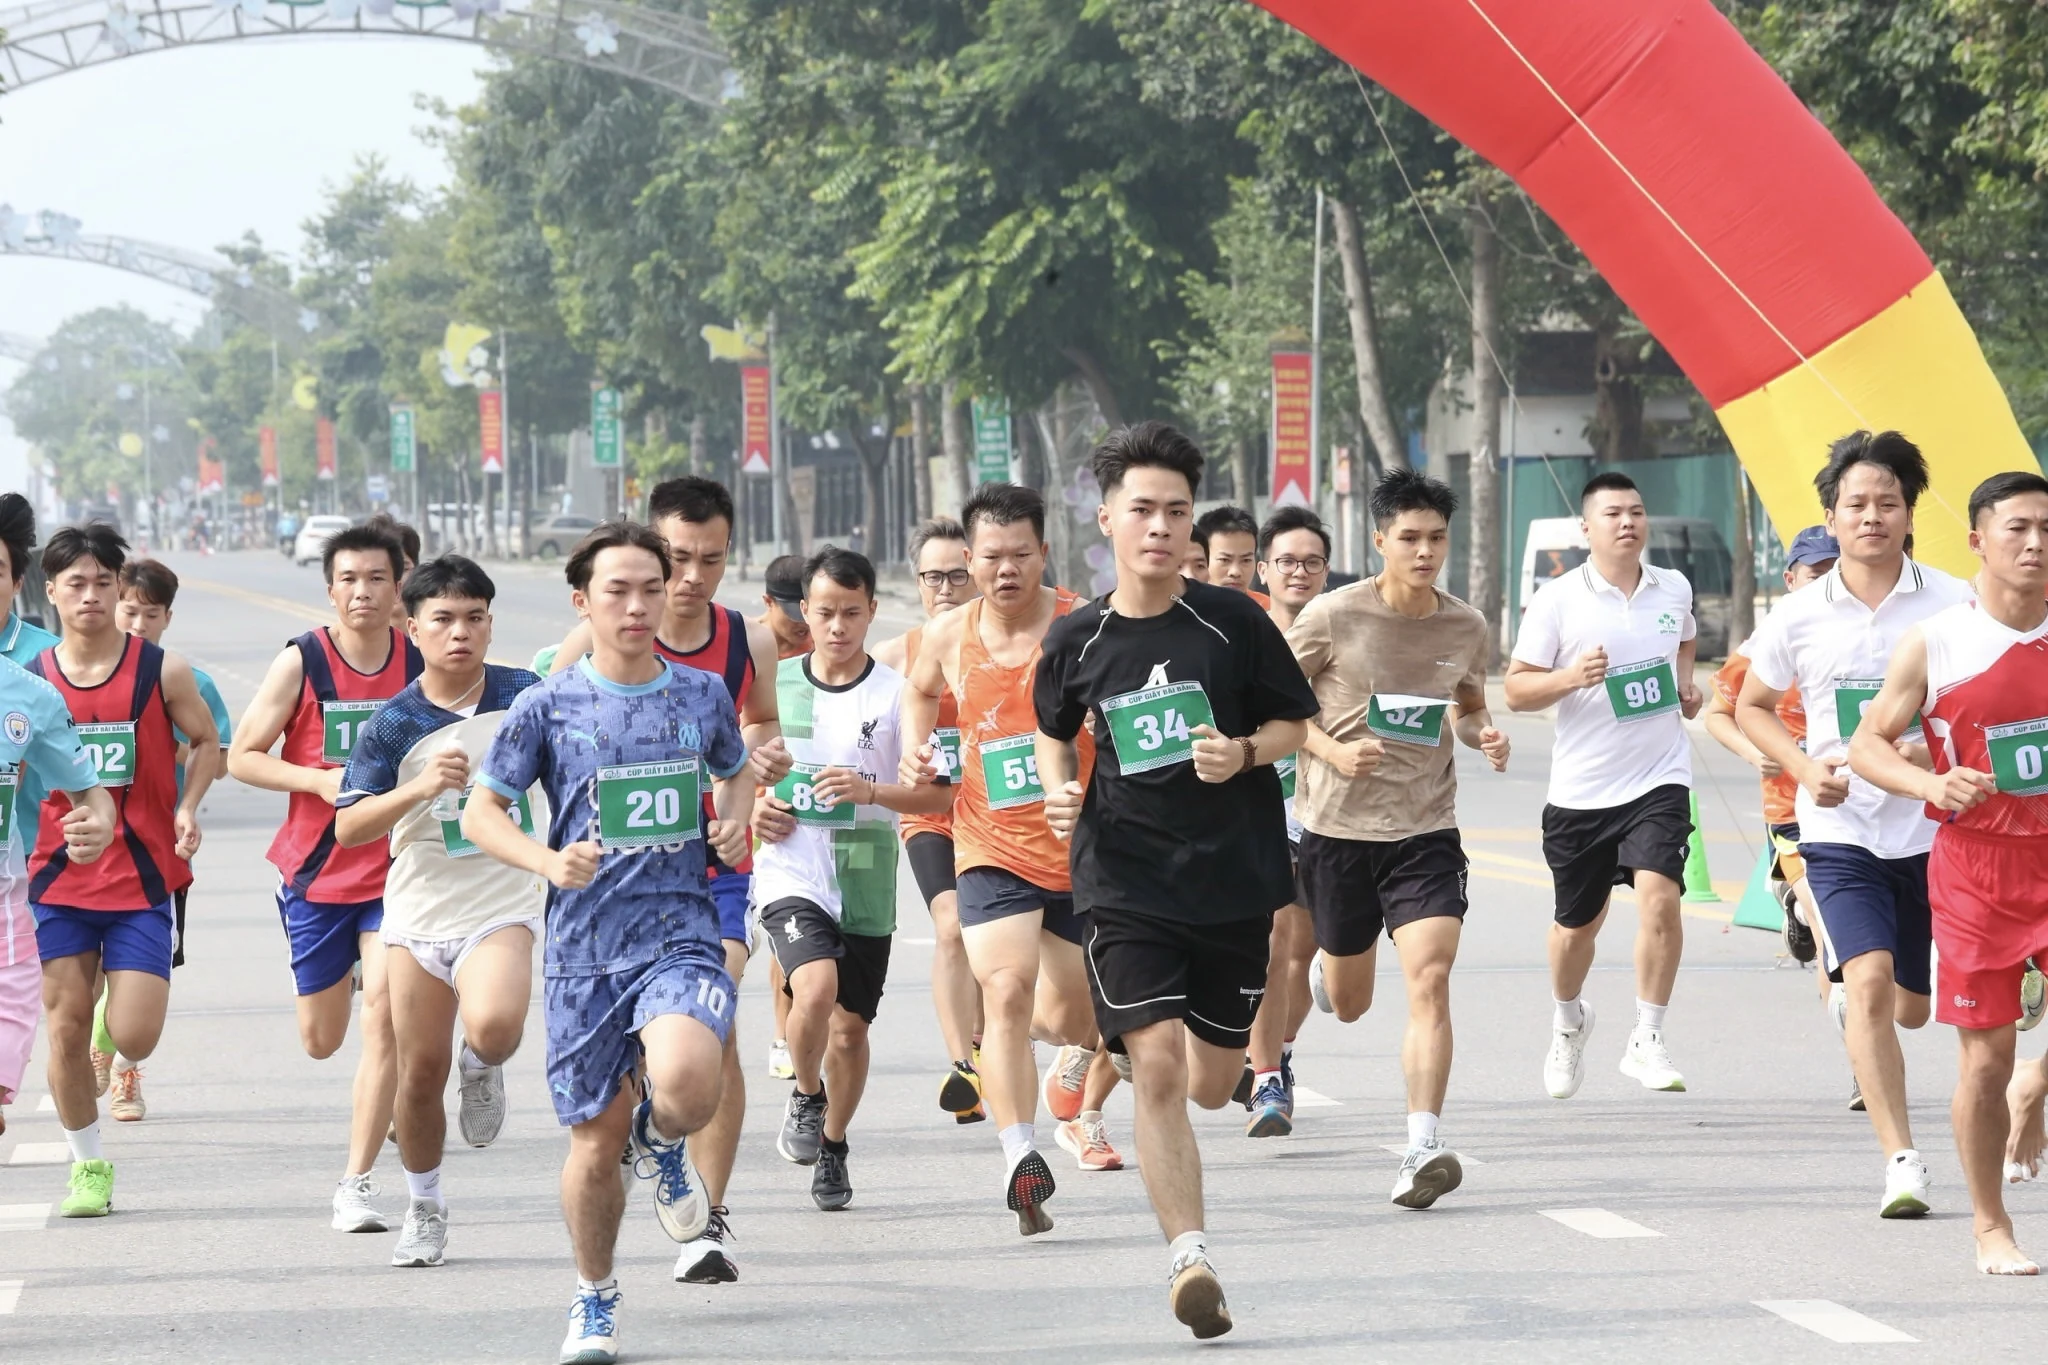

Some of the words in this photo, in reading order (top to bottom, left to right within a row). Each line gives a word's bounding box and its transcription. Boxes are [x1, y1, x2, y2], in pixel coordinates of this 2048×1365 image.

[1129, 695, 1143, 704] CÚP
[1624, 677, 1661, 708] 98
[1134, 708, 1191, 750] 34
[2014, 724, 2028, 734] CÚP
[627, 769, 643, 777] CÚP
[2015, 743, 2048, 780] 0
[627, 787, 680, 828] 20
[697, 977, 728, 1019] 10
